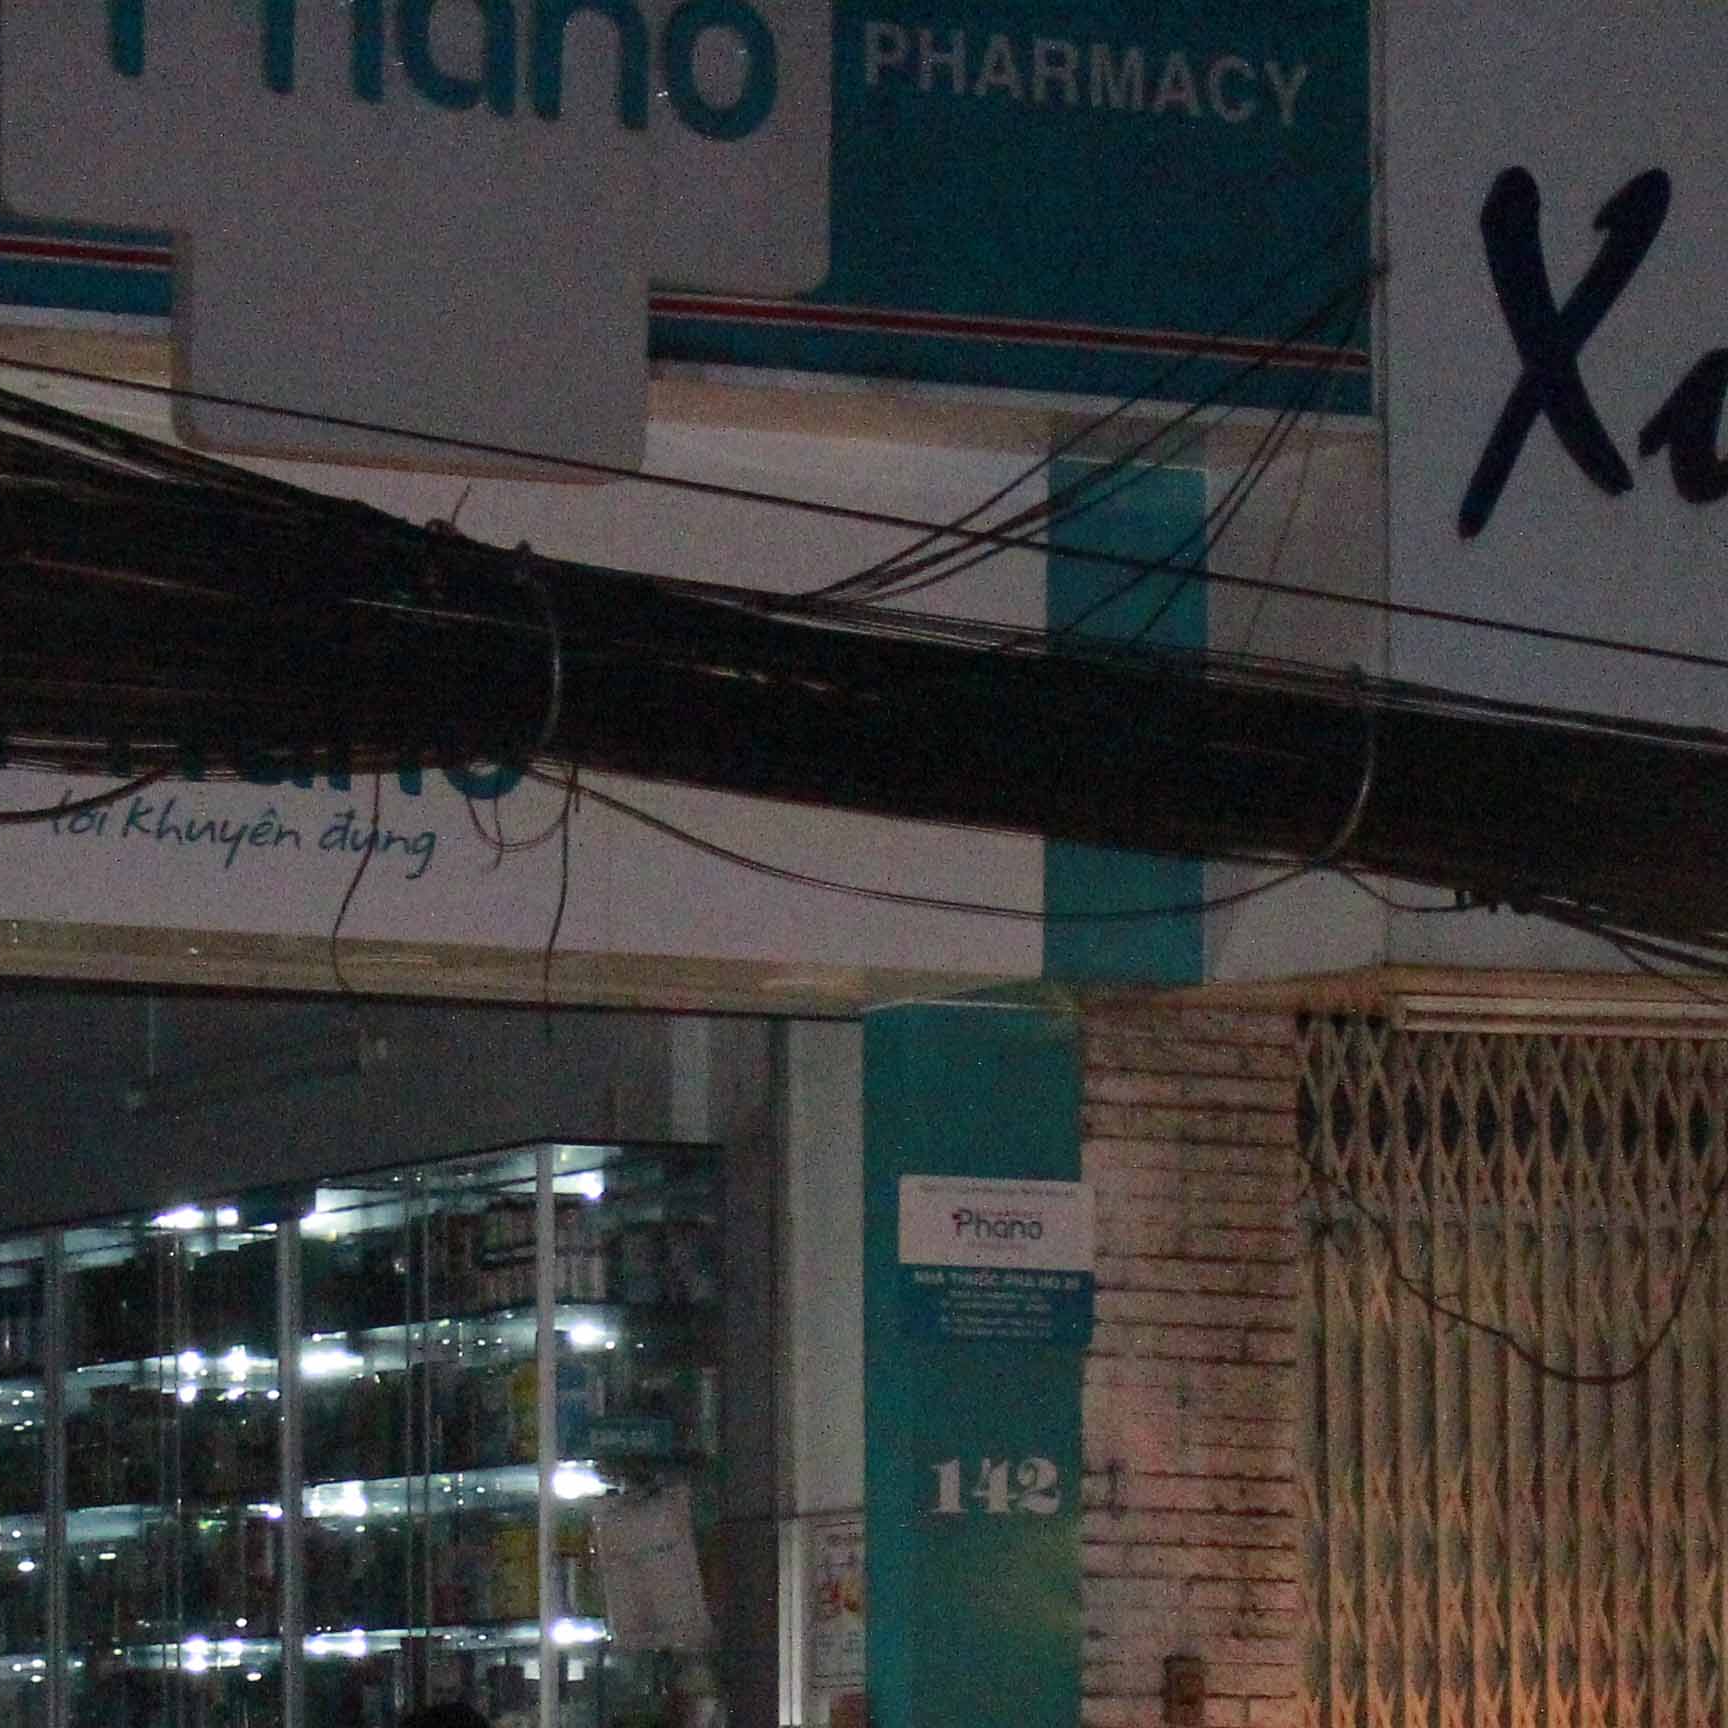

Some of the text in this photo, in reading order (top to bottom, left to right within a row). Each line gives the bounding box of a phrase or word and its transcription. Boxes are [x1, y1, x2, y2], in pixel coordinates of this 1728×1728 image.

[864, 21, 1308, 126] PHARMACY
[953, 1208, 1045, 1240] Phano
[929, 1455, 1063, 1515] 142
